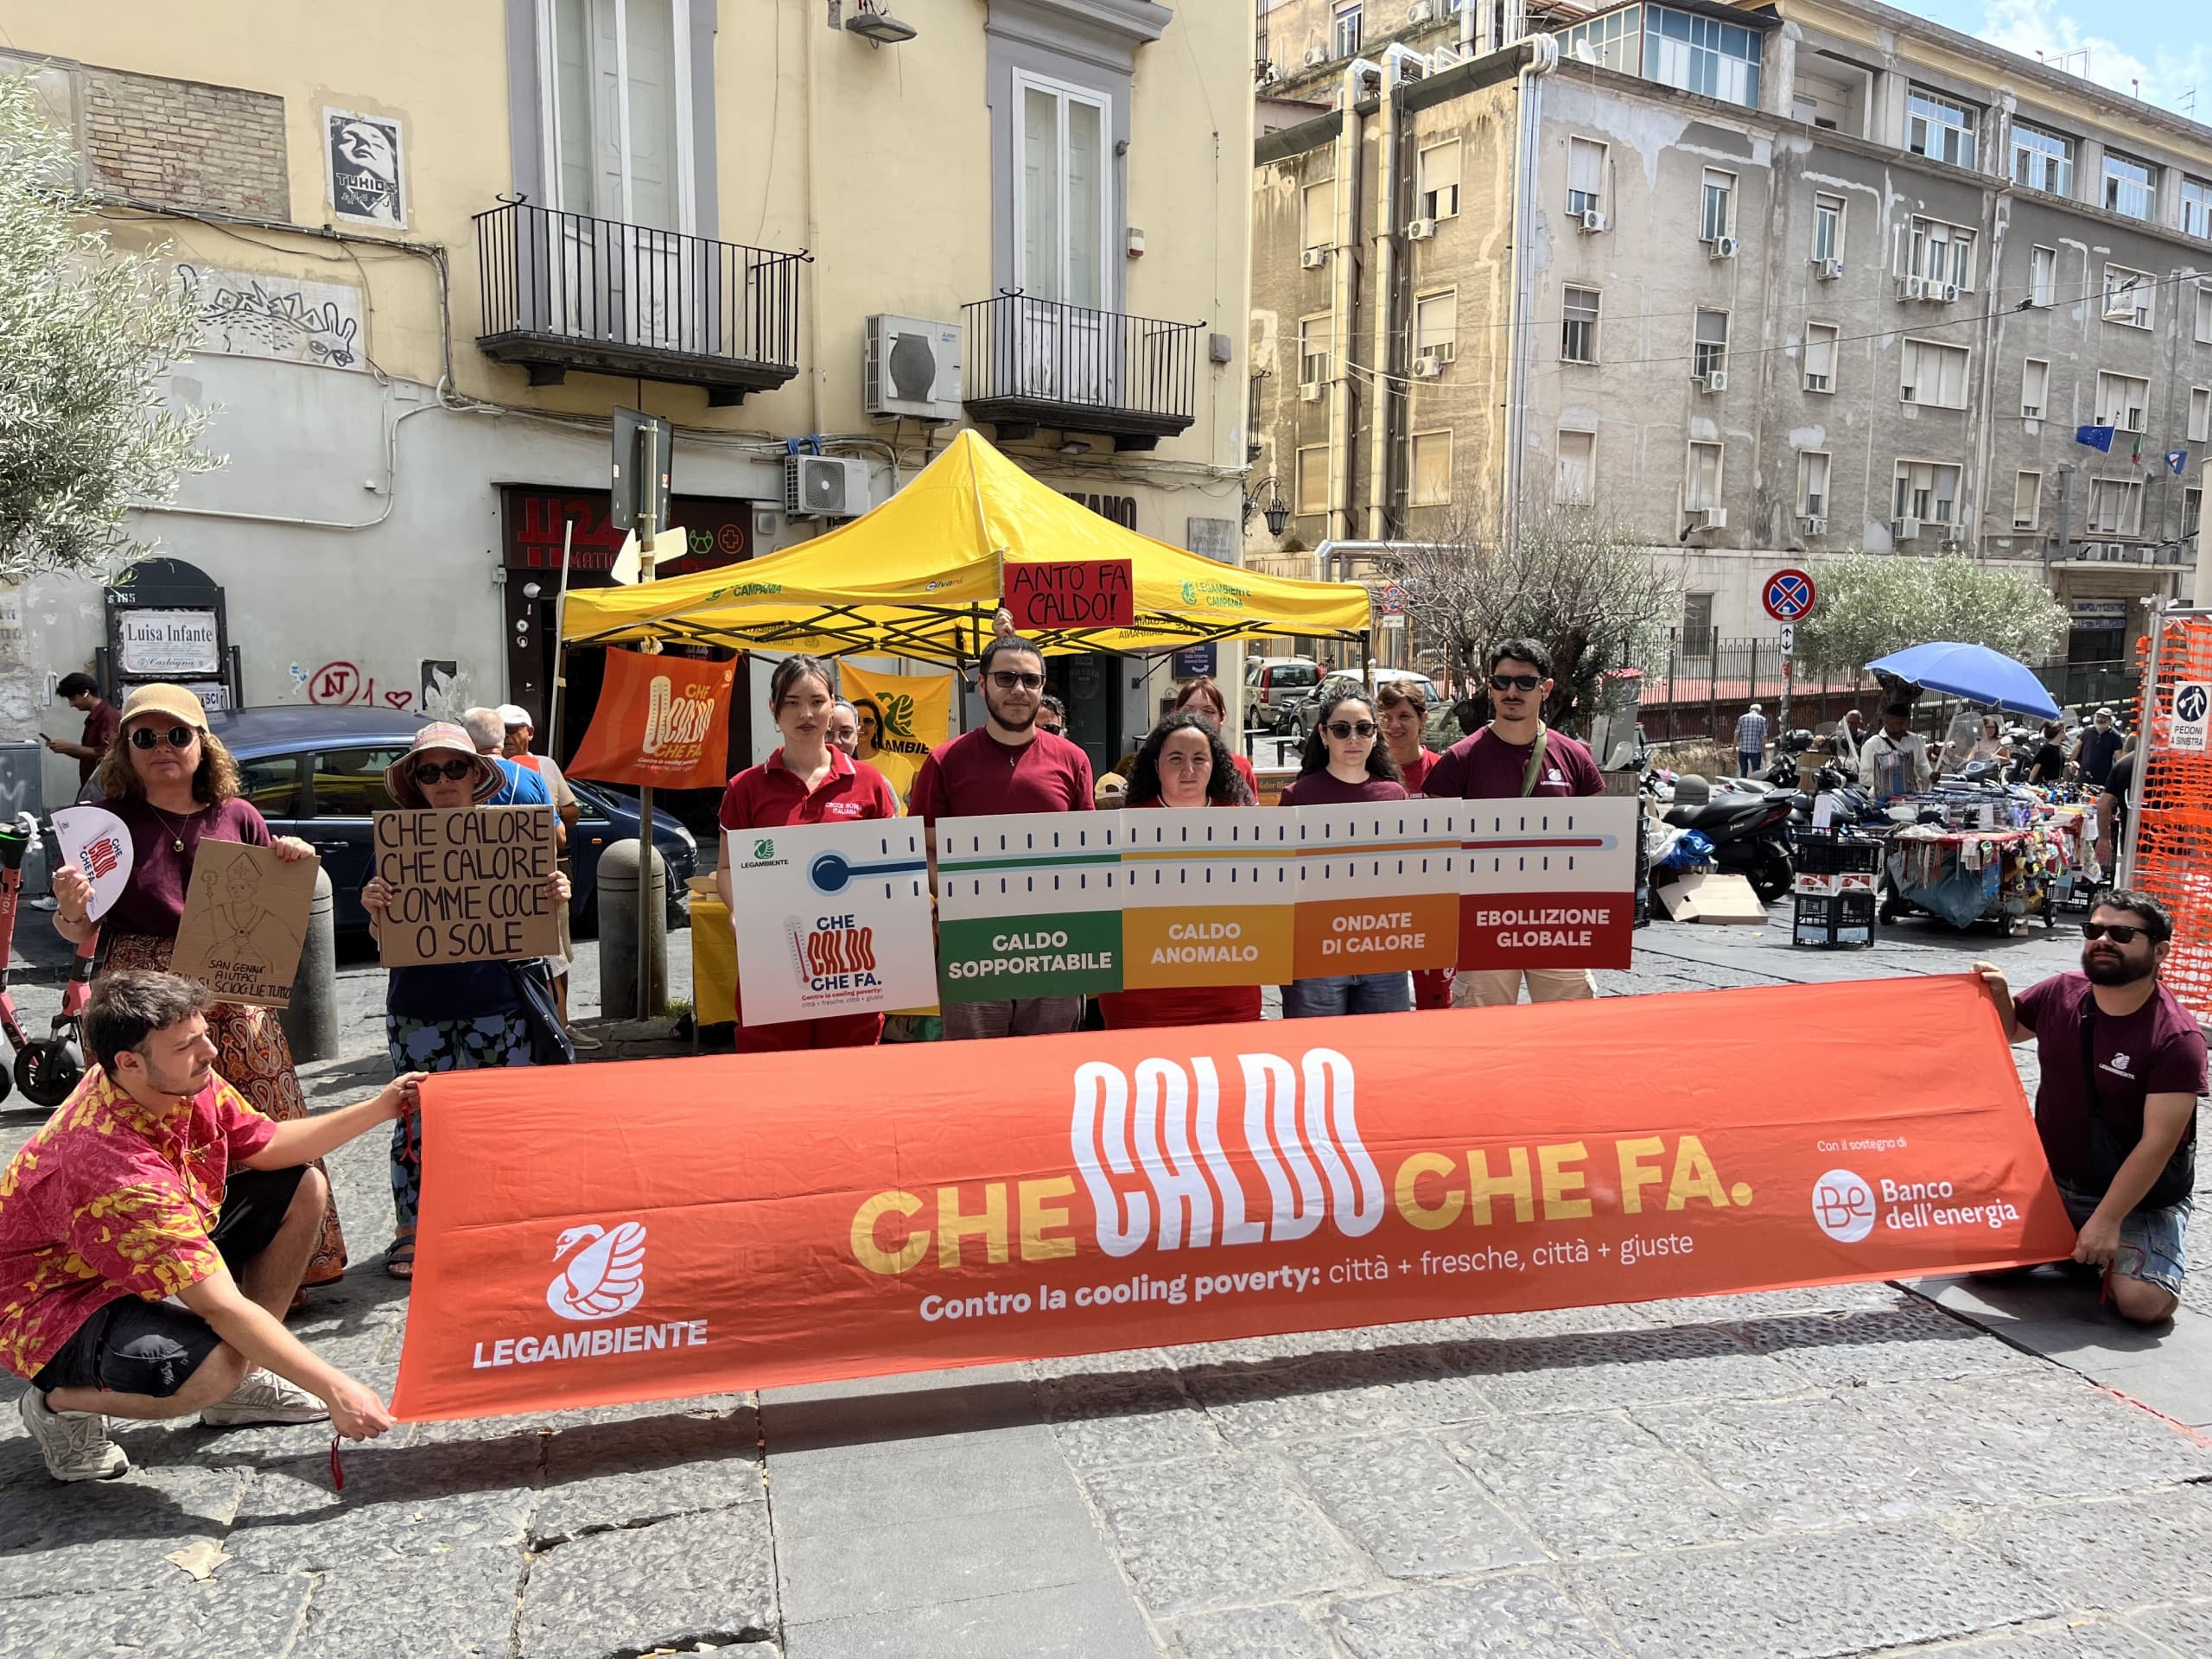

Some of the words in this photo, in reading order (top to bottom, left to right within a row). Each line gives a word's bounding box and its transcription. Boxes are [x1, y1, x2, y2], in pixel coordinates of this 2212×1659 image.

[1098, 564, 1128, 590] FA
[734, 582, 782, 597] CAMPANIA
[1196, 582, 1251, 598] LEGAMBIENTE
[1027, 593, 1117, 626] CALDO!
[1206, 595, 1243, 609] CAMPANIA
[127, 623, 162, 641] Luisa
[167, 624, 213, 642] Infante
[149, 658, 194, 668] Castagna
[2174, 726, 2202, 735] PEDONI
[653, 744, 686, 758] CHE
[2176, 737, 2202, 746] SINISTRA
[378, 812, 437, 848] CHE
[446, 810, 550, 845] CALORE
[111, 838, 123, 858] CHE
[79, 850, 92, 872] CHE
[381, 849, 436, 886] CHE
[443, 846, 549, 882] CALORE
[741, 859, 789, 868] LEGAMBIENTE
[385, 886, 481, 924] COMME
[488, 883, 549, 918] COCE
[817, 914, 855, 931] CHE
[1332, 912, 1412, 932] ONDATE
[1476, 908, 1611, 926] EBOLLIZIONE
[416, 925, 436, 958] O
[448, 921, 523, 957] SOLE
[992, 931, 1068, 951] CALDO
[1168, 923, 1242, 941] CALDO
[1497, 931, 1592, 948] GLOBALE
[807, 927, 876, 976] CALDO
[1322, 938, 1341, 955] DI
[1346, 932, 1426, 953] CALORE
[208, 959, 231, 969] SAN
[1150, 945, 1258, 964] ANOMALO
[948, 951, 1112, 980] SOPPORTABILE
[215, 970, 257, 982] AIUTACI
[810, 974, 849, 991] CHE
[854, 972, 882, 988] FA.
[213, 981, 266, 997] SCIOGLIE
[268, 985, 292, 1000] TUTTO
[831, 989, 855, 999] cooling
[1817, 1140, 1839, 1152] Con
[1841, 1139, 1847, 1150] il
[1849, 1139, 1895, 1152] sostegno
[1897, 1136, 1907, 1147] di
[850, 1175, 1077, 1275] CHE
[1071, 1048, 1384, 1257] CALDO
[1394, 1141, 1592, 1230] CHE
[1615, 1135, 1753, 1214] FA.
[1880, 1179, 1953, 1203] Banco
[1885, 1198, 2020, 1230] dell'energia
[920, 1293, 1032, 1321] Contro
[1040, 1284, 1066, 1311] la
[1075, 1273, 1188, 1306] cooling
[1195, 1265, 1321, 1301] poverty:
[1328, 1254, 1389, 1284] città
[1398, 1260, 1412, 1274] +
[1420, 1244, 1526, 1279] fresche,
[1533, 1238, 1590, 1267] città
[1598, 1243, 1611, 1258] +
[1620, 1232, 1694, 1265] giuste
[473, 1319, 708, 1369] LEGAMBIENTE
